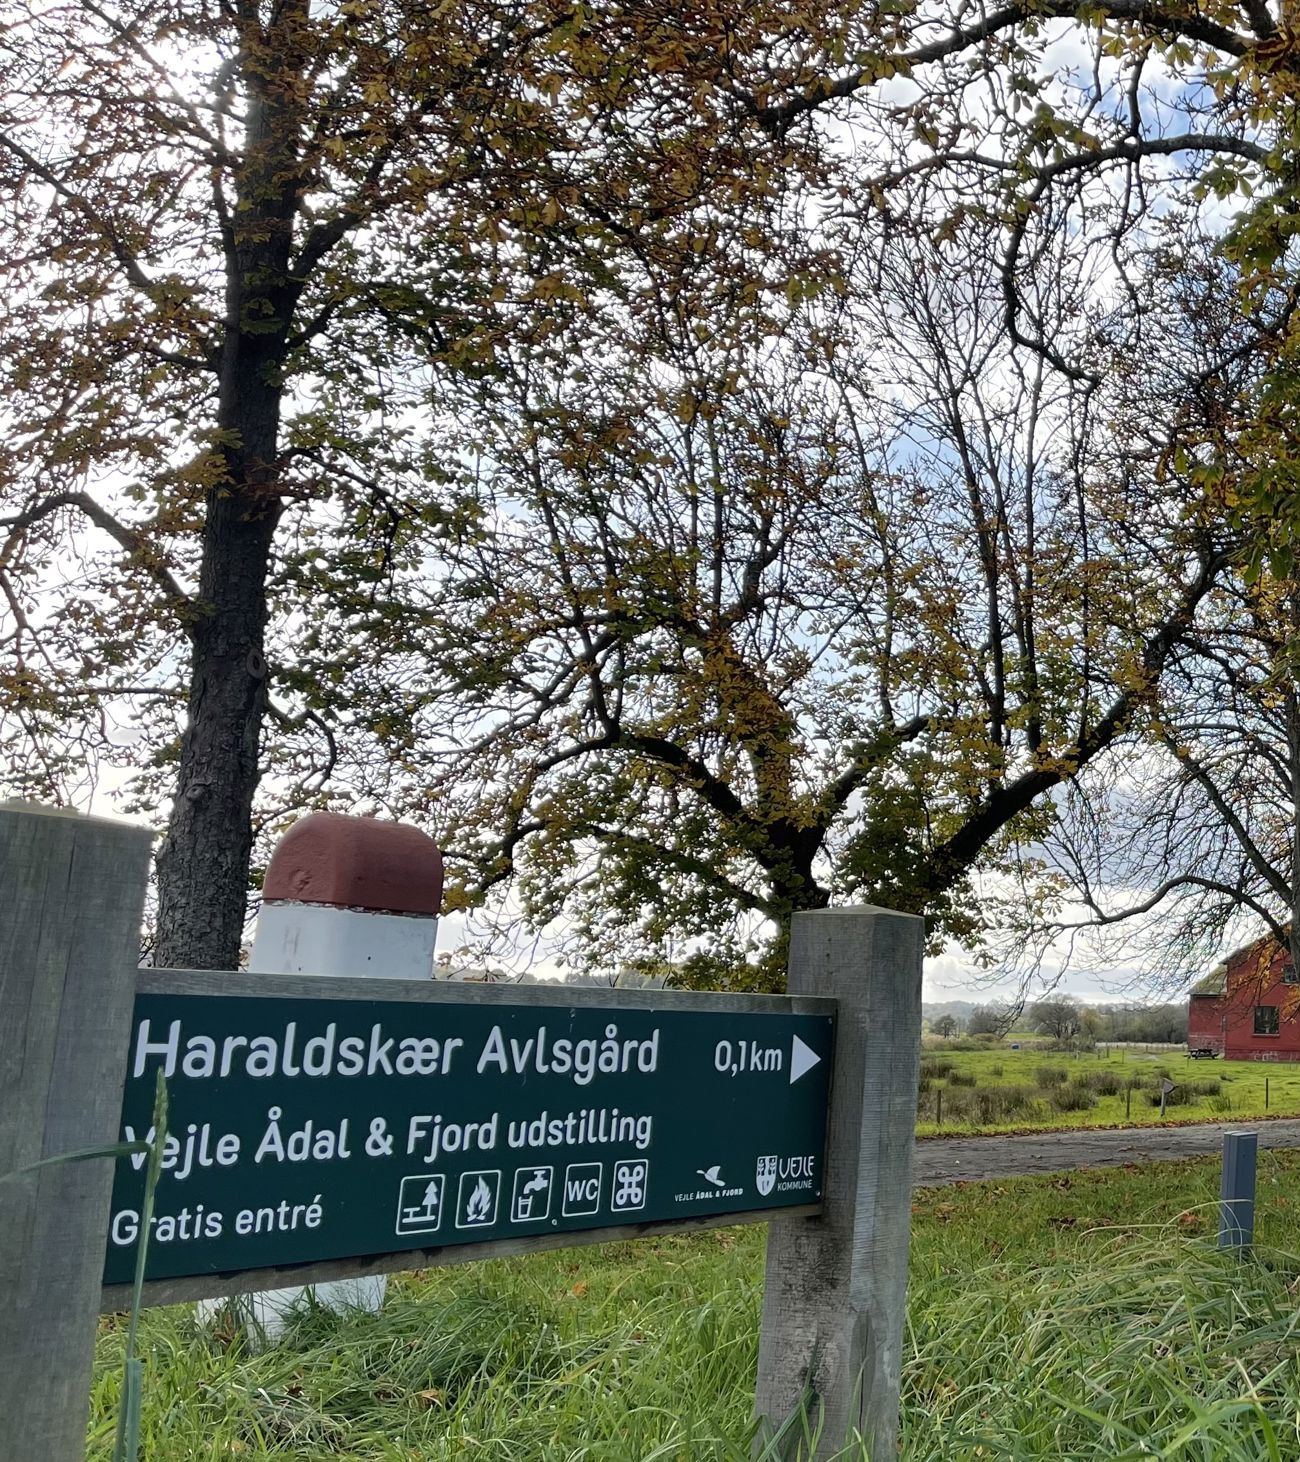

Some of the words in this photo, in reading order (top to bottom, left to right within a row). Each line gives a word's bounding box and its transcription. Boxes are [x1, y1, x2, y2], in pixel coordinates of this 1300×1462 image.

[133, 1019, 463, 1078] Haraldskær
[476, 1023, 660, 1086] Avlsgård
[124, 1123, 241, 1180] Vejle
[254, 1106, 351, 1164] Ådal
[365, 1117, 393, 1157] &
[406, 1112, 498, 1164] Fjord
[507, 1108, 652, 1150] udstilling
[779, 1155, 815, 1179] VEJLE
[567, 1179, 599, 1202] WC
[674, 1192, 694, 1202] VEJLE
[721, 1188, 744, 1197] FJORD
[777, 1179, 813, 1192] KOMMUNE
[235, 1194, 323, 1235] entré
